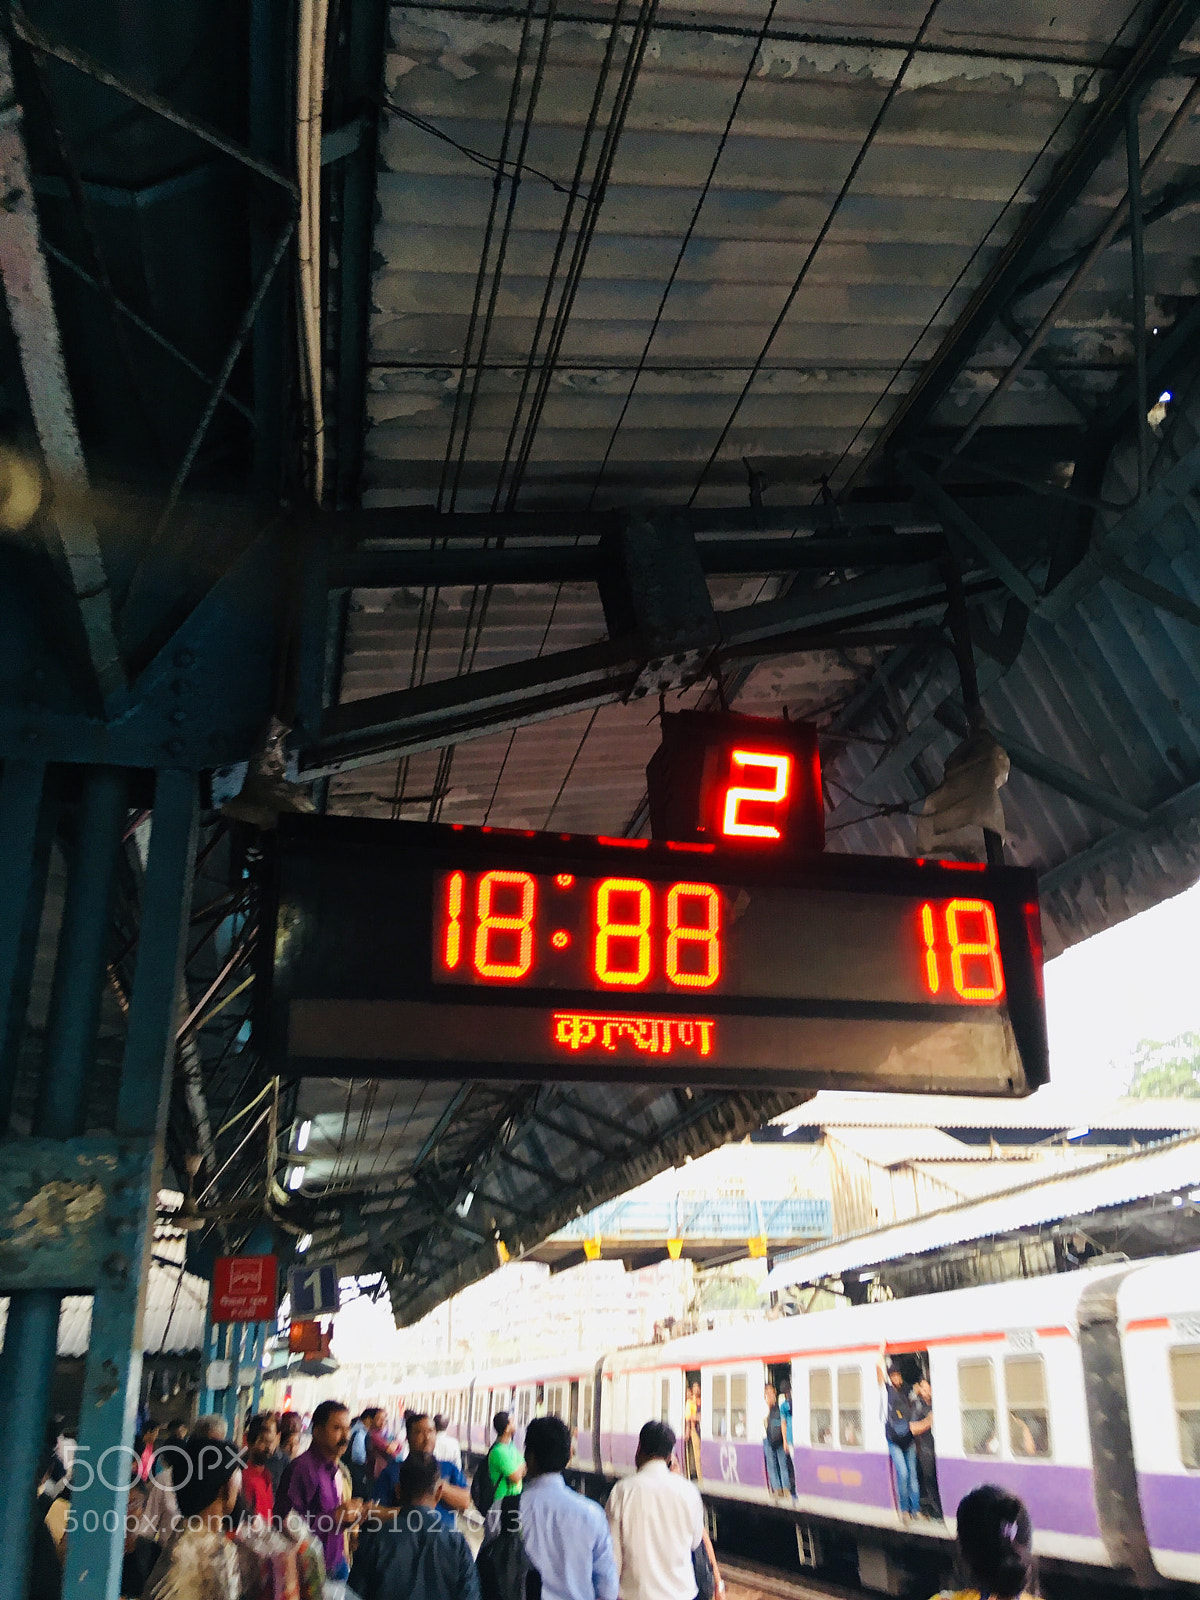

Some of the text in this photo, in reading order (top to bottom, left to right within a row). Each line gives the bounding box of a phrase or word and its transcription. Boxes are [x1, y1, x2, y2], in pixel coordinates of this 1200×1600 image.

[722, 749, 793, 839] 2
[921, 899, 1005, 1001] 18
[552, 1012, 715, 1056] कल्याण
[303, 1268, 322, 1311] 1
